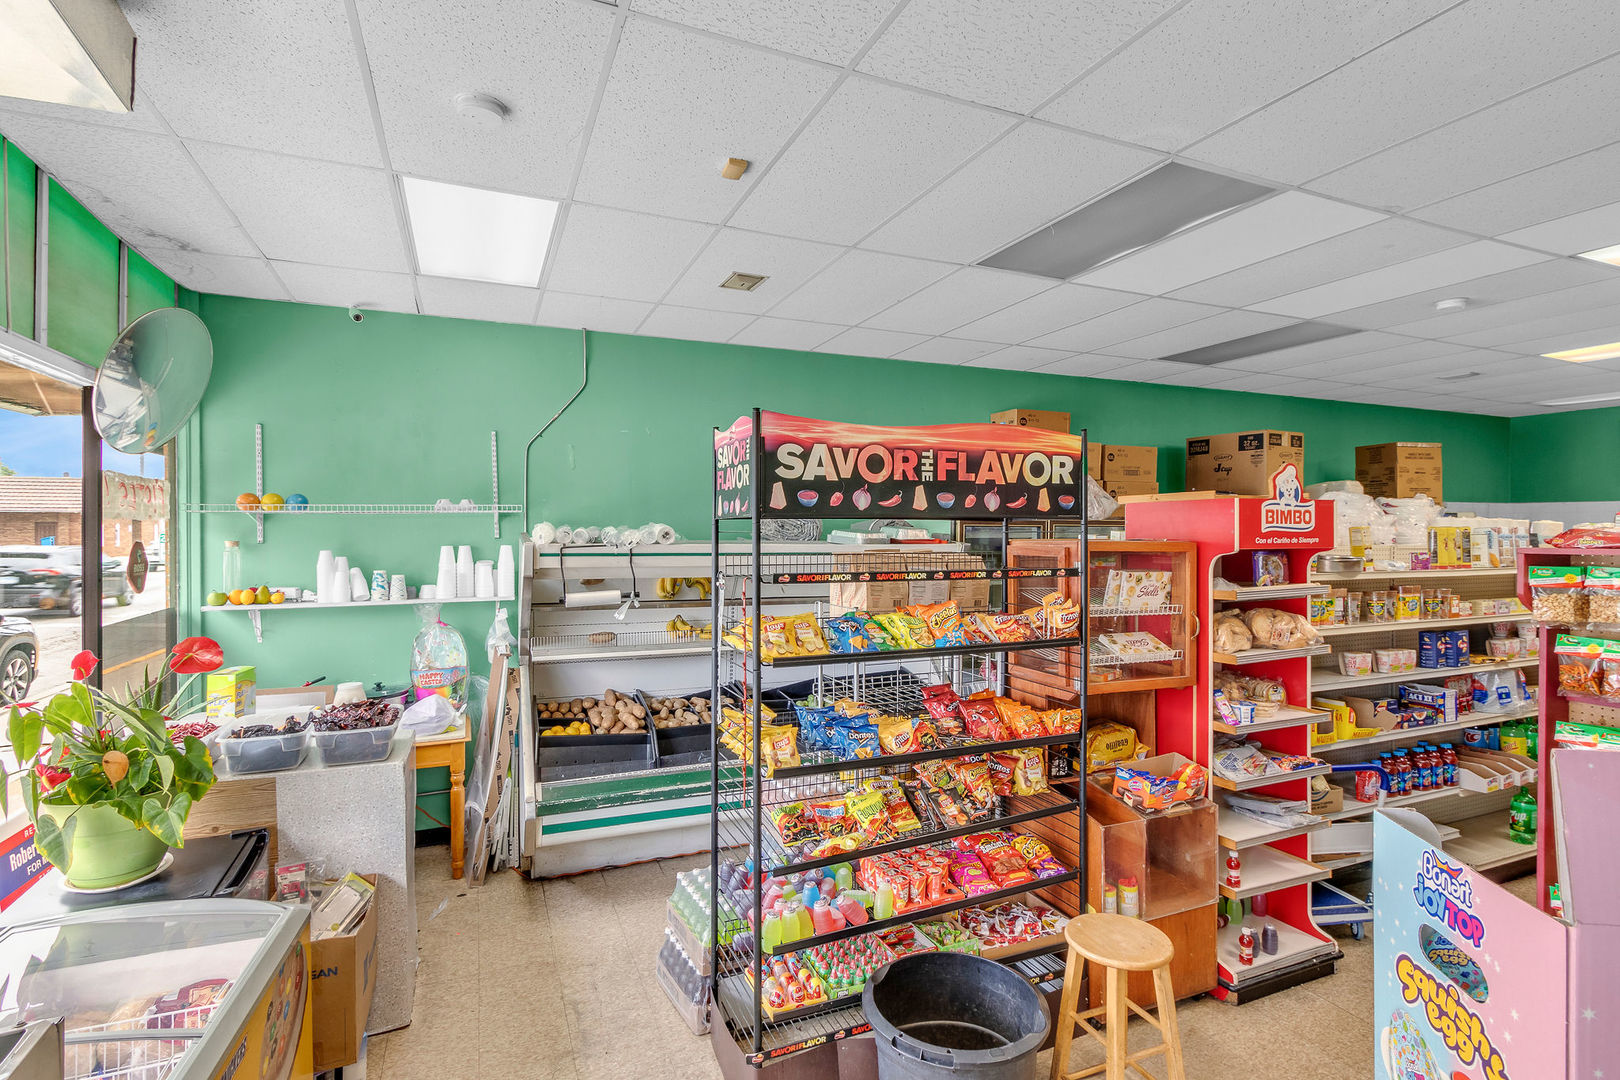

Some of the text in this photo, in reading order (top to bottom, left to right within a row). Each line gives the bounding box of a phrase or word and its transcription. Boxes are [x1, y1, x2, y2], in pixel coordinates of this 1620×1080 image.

[716, 440, 746, 468] SAVOR
[774, 443, 919, 483] SAVOR
[921, 449, 934, 482] THE
[937, 450, 1074, 487] FLAVOR
[717, 464, 750, 491] FLAVOR
[1265, 509, 1312, 525] BIMBO
[1273, 536, 1291, 544] Cariño
[1298, 536, 1320, 545] Siempre
[1137, 583, 1160, 598] Shells
[931, 606, 957, 628] Cheetos
[419, 672, 443, 680] HAPPY
[848, 731, 875, 740] Doritos
[27, 859, 41, 875] FOR
[1422, 850, 1472, 908] Bonart
[852, 1024, 873, 1035] SAVO
[1426, 1000, 1475, 1065] egg
[771, 1036, 827, 1057] SAVOR FLAVOR
